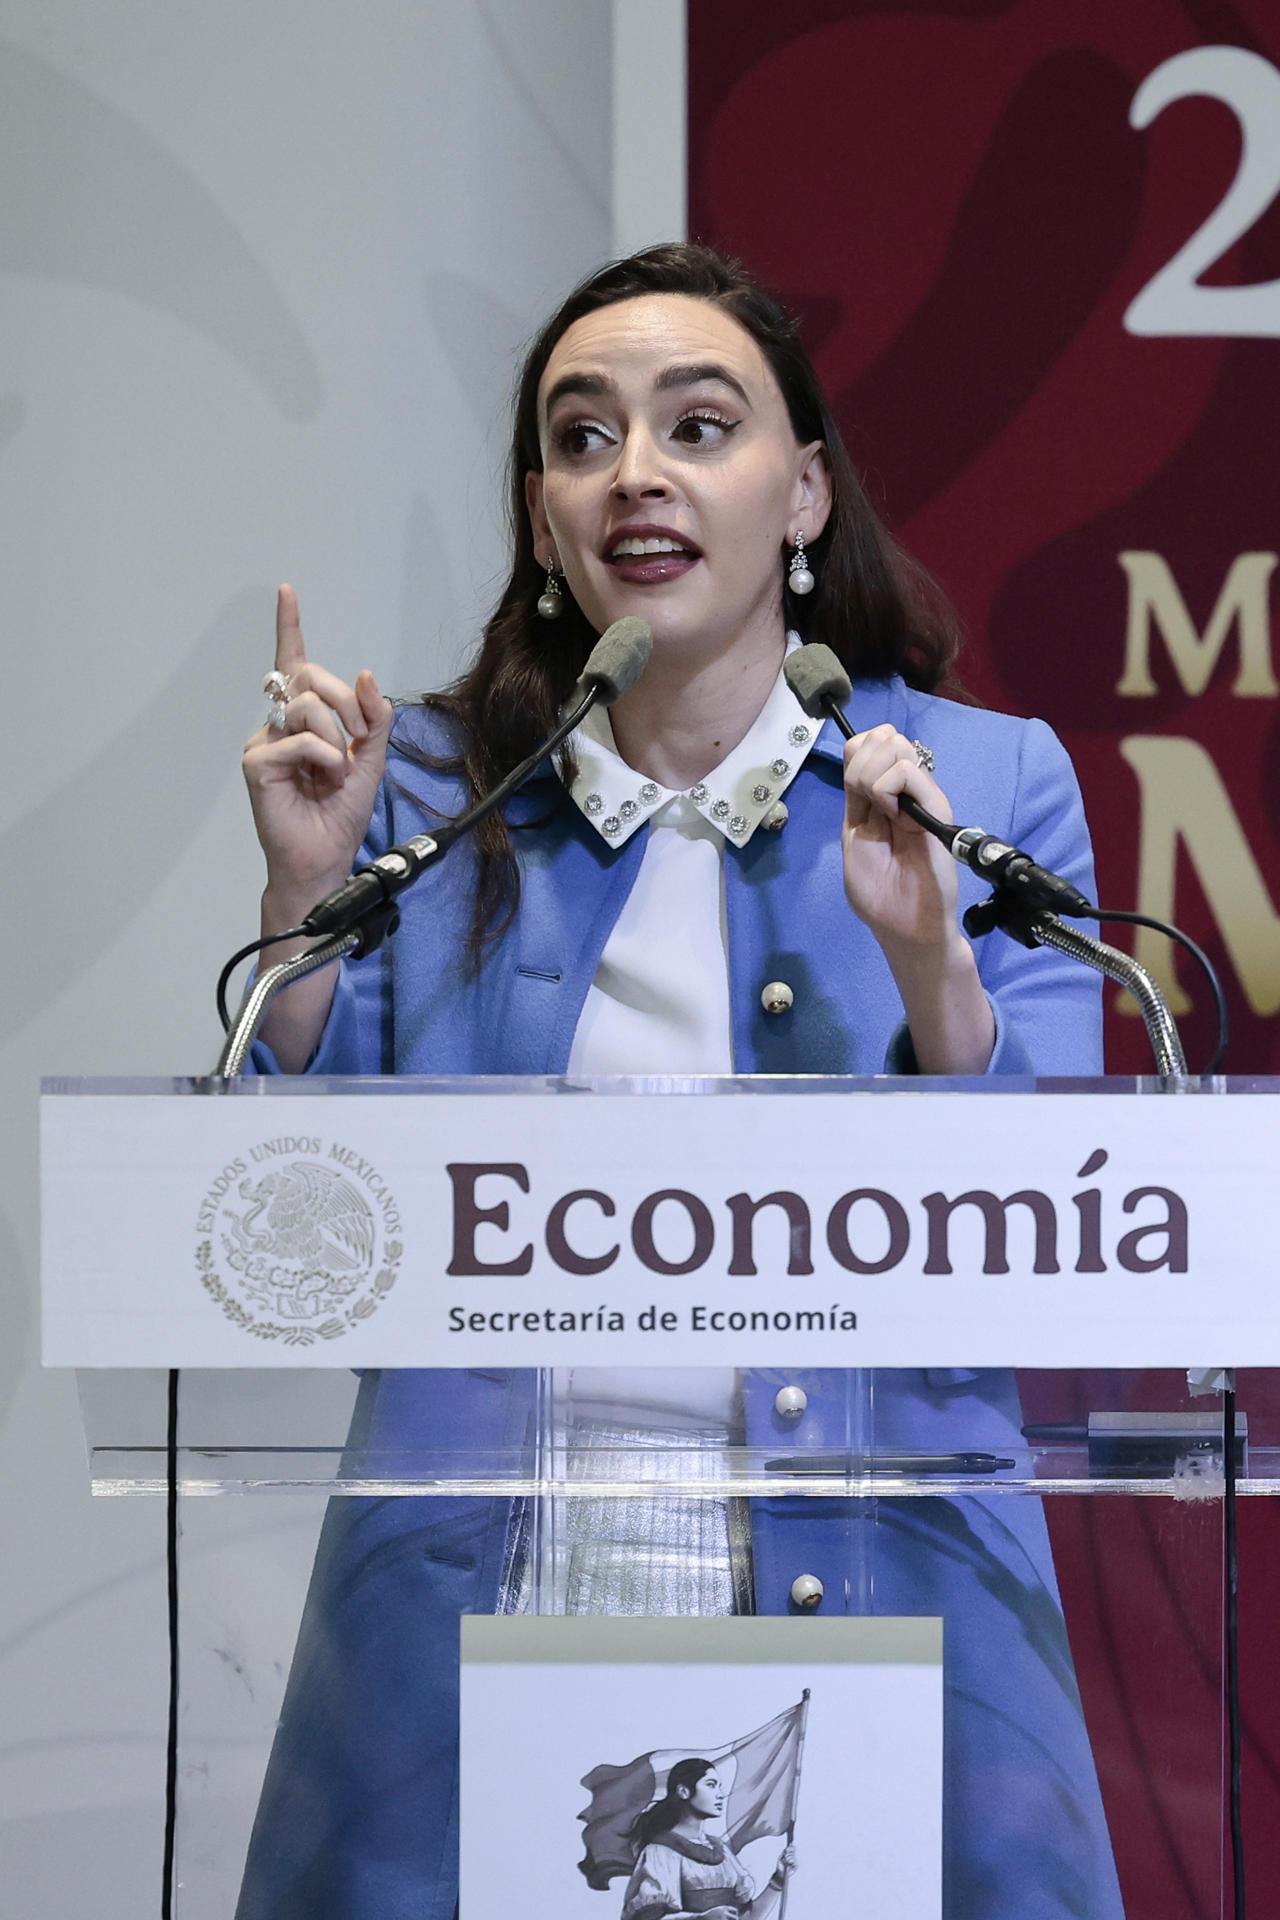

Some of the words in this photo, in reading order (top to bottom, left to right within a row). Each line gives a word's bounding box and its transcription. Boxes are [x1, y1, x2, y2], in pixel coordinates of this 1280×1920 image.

[1122, 45, 1280, 338] 2
[1116, 550, 1278, 696] M
[196, 1157, 248, 1234] ESTADOS
[249, 1136, 321, 1162] UNIDOS
[328, 1143, 403, 1235] MEXICANOS
[445, 1148, 1189, 1277] Economía
[448, 1304, 625, 1333] Secretaría
[637, 1304, 678, 1332] de
[691, 1303, 857, 1332] Economía
